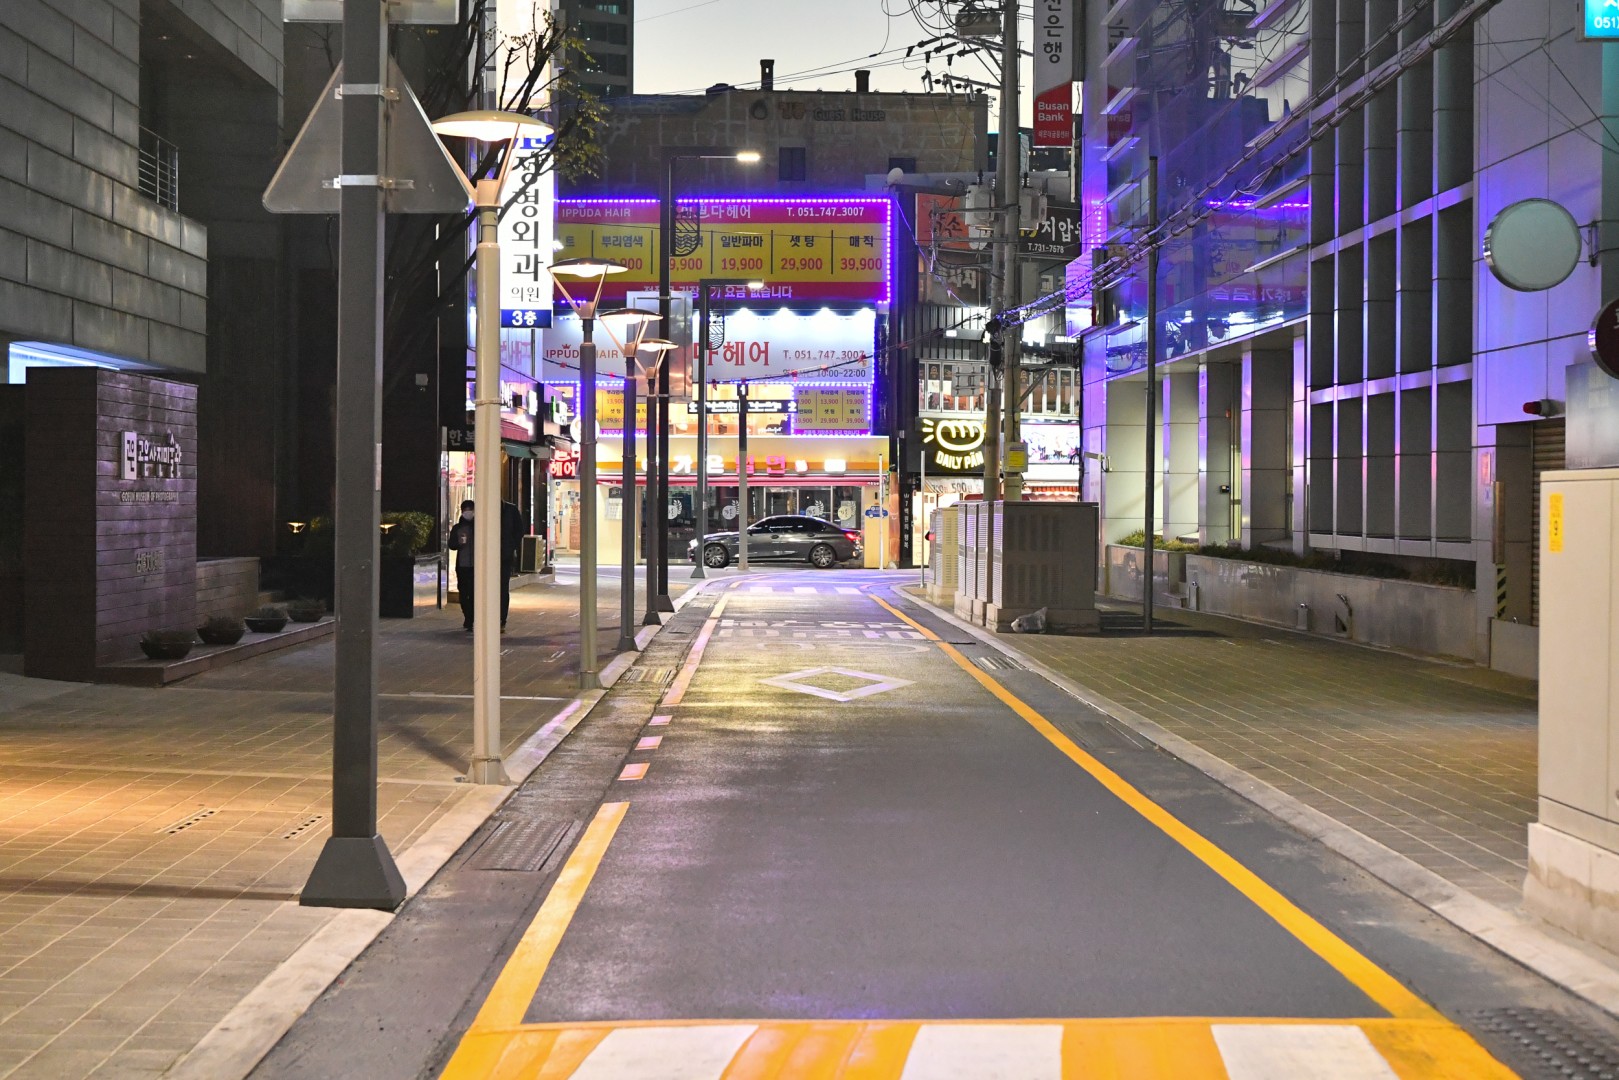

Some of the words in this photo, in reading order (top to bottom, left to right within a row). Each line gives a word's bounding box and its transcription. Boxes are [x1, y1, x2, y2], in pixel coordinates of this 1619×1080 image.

[1038, 102, 1069, 111] Busan
[815, 108, 845, 121] Guest
[853, 108, 885, 121] House
[1038, 112, 1064, 121] Bank
[562, 208, 602, 217] IPPUDA
[604, 208, 631, 217] HAIR
[602, 235, 643, 247] 뿌리염색
[720, 236, 763, 248] 일반파마
[720, 258, 763, 271] 19,900
[780, 258, 823, 271] 29,900
[840, 258, 883, 271] 39,900
[511, 286, 541, 303] 의원
[724, 286, 746, 299] 요금
[511, 311, 538, 326] 3층
[546, 350, 580, 359] IPPUD
[936, 450, 963, 470] DAILY
[549, 461, 576, 477] 헤어
